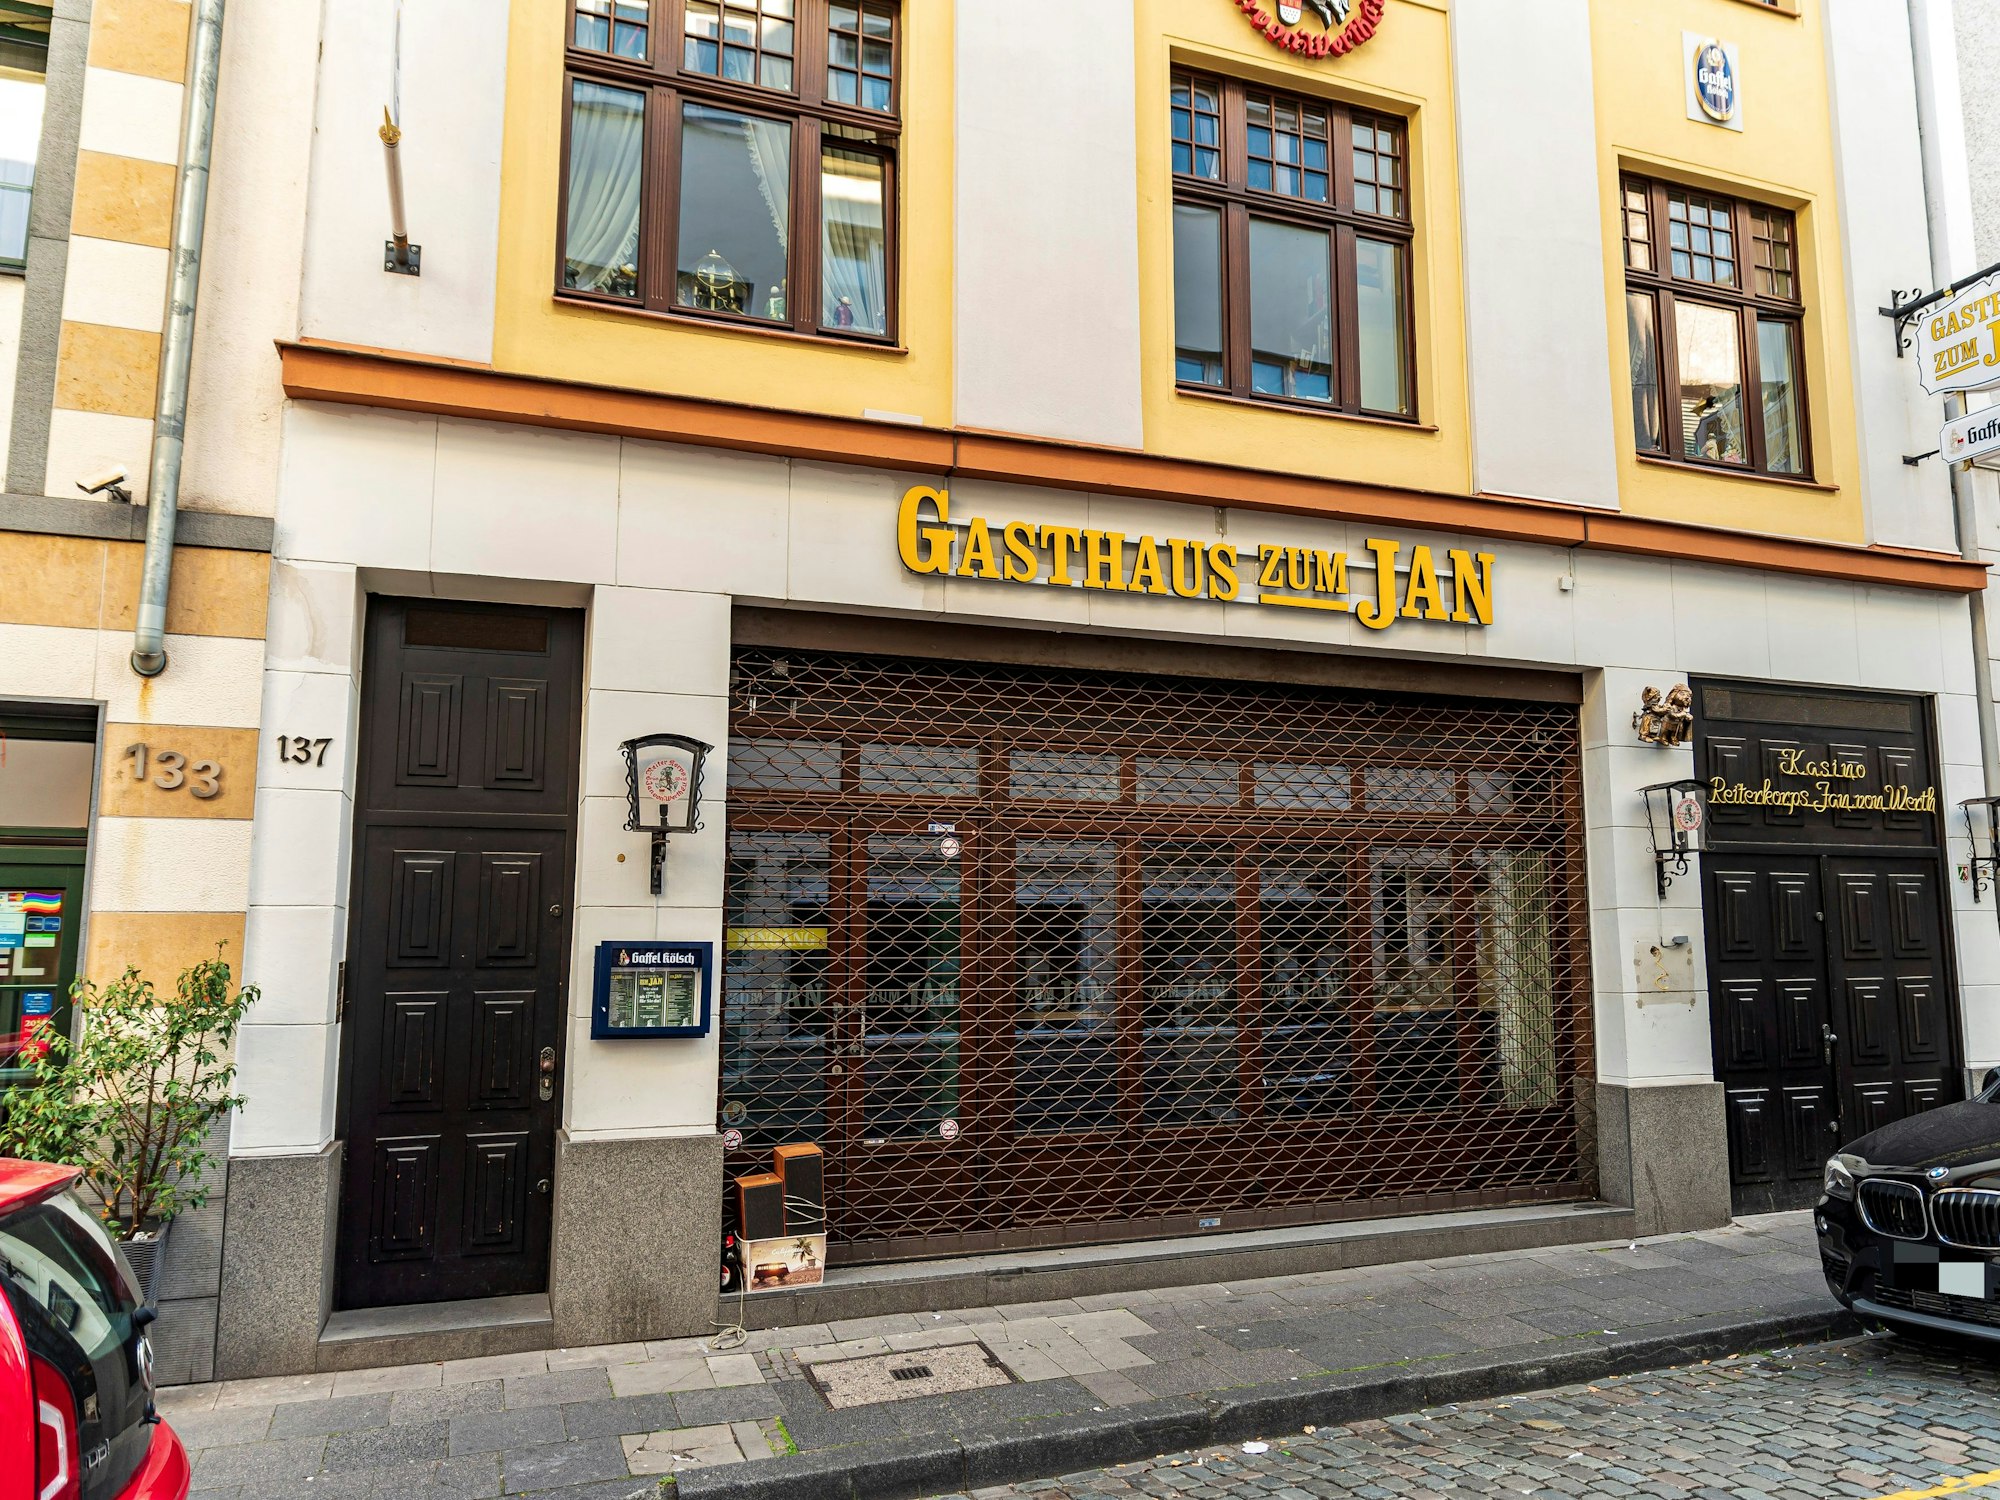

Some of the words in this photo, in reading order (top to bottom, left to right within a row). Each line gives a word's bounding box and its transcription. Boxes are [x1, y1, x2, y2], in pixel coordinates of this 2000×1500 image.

[1699, 68, 1732, 91] Gaffel
[1934, 337, 1979, 373] ZUM
[896, 484, 1240, 602] GASTHAUS
[1257, 543, 1349, 596] ZUM
[1355, 537, 1495, 631] JAN
[276, 734, 334, 768] 137
[1779, 748, 1867, 780] Kasino
[125, 741, 222, 799] 133
[1709, 776, 1810, 815] Reiterkorps
[1884, 784, 1937, 815] Werth
[631, 951, 662, 965] Gaffel
[662, 952, 695, 965] Kölsch
[766, 982, 824, 1015] JAN
[868, 990, 901, 1004] ZUM
[903, 981, 961, 1014] JAN
[1058, 979, 1106, 1011] JAN
[88, 1438, 110, 1469] up!
